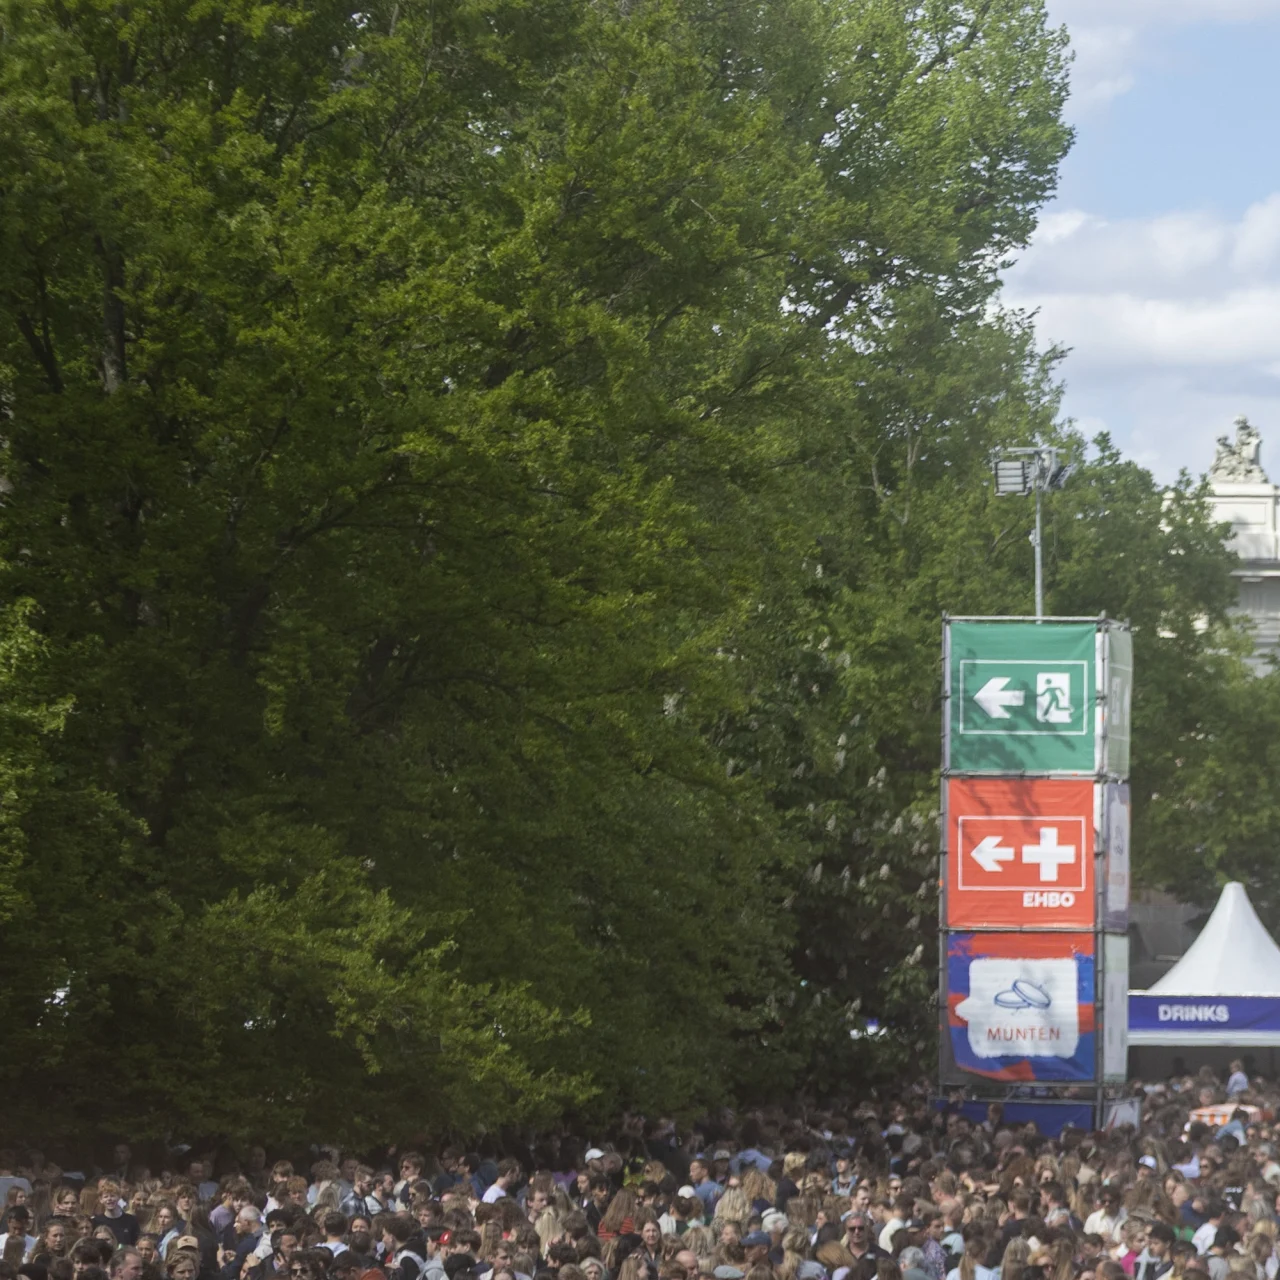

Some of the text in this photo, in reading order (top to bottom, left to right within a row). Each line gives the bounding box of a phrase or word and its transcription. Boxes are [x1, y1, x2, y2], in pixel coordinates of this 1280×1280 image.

[1022, 891, 1076, 908] EHBO
[1158, 1003, 1230, 1022] DRINKS
[986, 1027, 1061, 1042] MUNTEN
